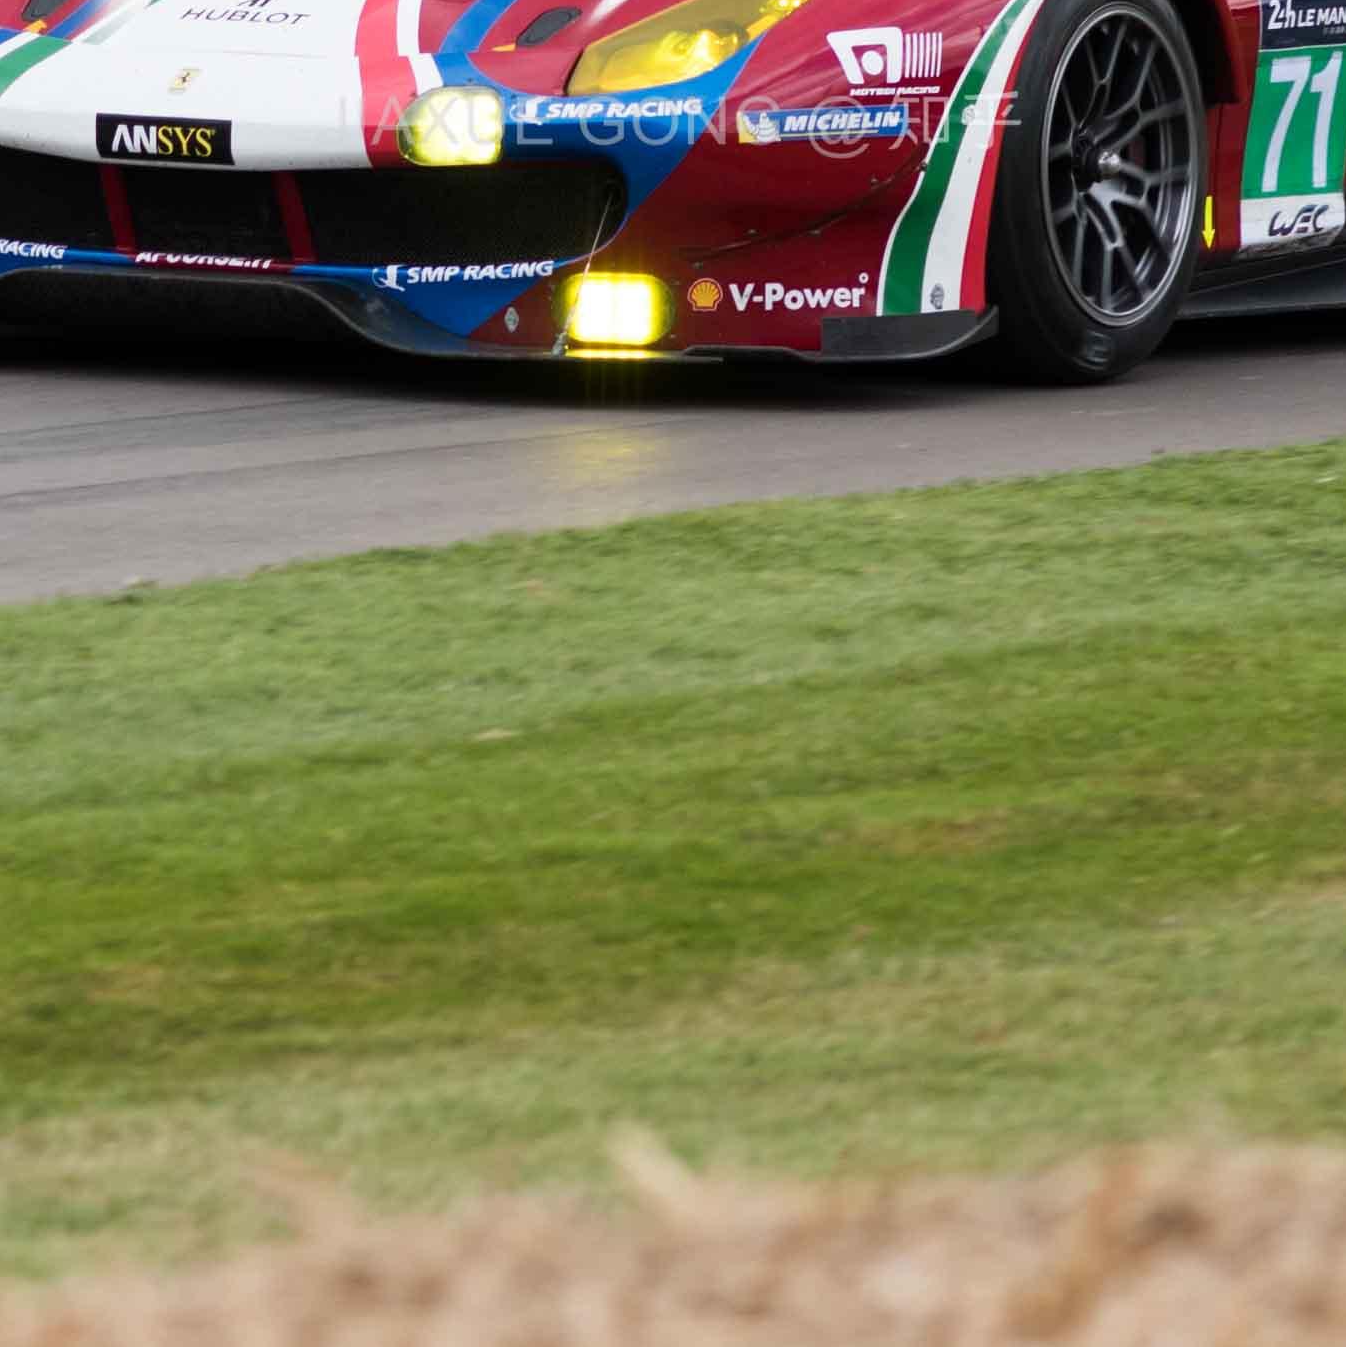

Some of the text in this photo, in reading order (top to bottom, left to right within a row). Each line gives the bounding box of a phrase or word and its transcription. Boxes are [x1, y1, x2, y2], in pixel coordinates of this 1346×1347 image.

[180, 8, 312, 27] HUBLOT
[1297, 8, 1315, 27] LE
[545, 97, 703, 120] SMP RACING
[783, 110, 902, 133] MICHELIN
[1261, 50, 1343, 193] 71
[111, 124, 216, 159] ANSYS
[1268, 205, 1330, 237] WEC
[406, 259, 554, 285] SMP RACING
[729, 281, 867, 312] V-Power
